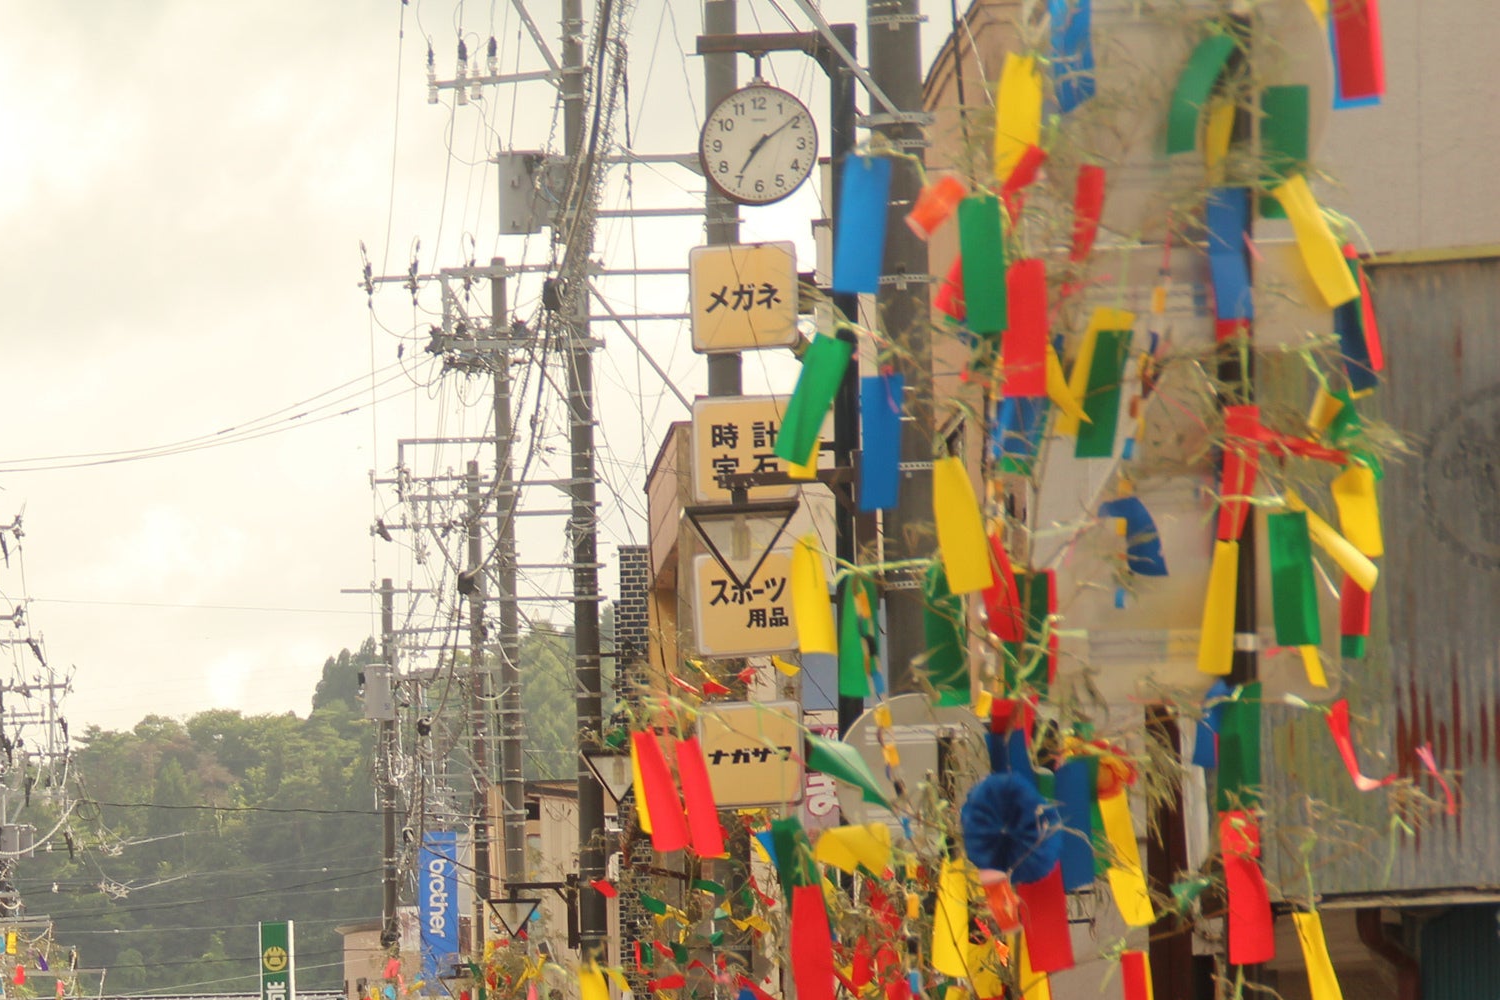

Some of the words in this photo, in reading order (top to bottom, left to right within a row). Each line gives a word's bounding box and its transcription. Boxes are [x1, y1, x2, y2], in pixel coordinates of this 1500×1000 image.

[733, 103, 746, 116] 11
[751, 97, 767, 110] 12
[777, 103, 783, 115] 1
[718, 118, 734, 132] 10
[791, 115, 801, 129] 2
[712, 139, 723, 153] 9
[796, 137, 806, 150] 3
[718, 160, 729, 174] 8
[790, 159, 800, 172] 4
[735, 175, 744, 188] 7
[755, 180, 765, 193] 6
[775, 174, 785, 187] 5
[705, 282, 782, 313] メガネ
[711, 420, 779, 449] 時計
[709, 577, 787, 606] スポーツ
[746, 607, 789, 629] 用品
[428, 858, 449, 938] brother
